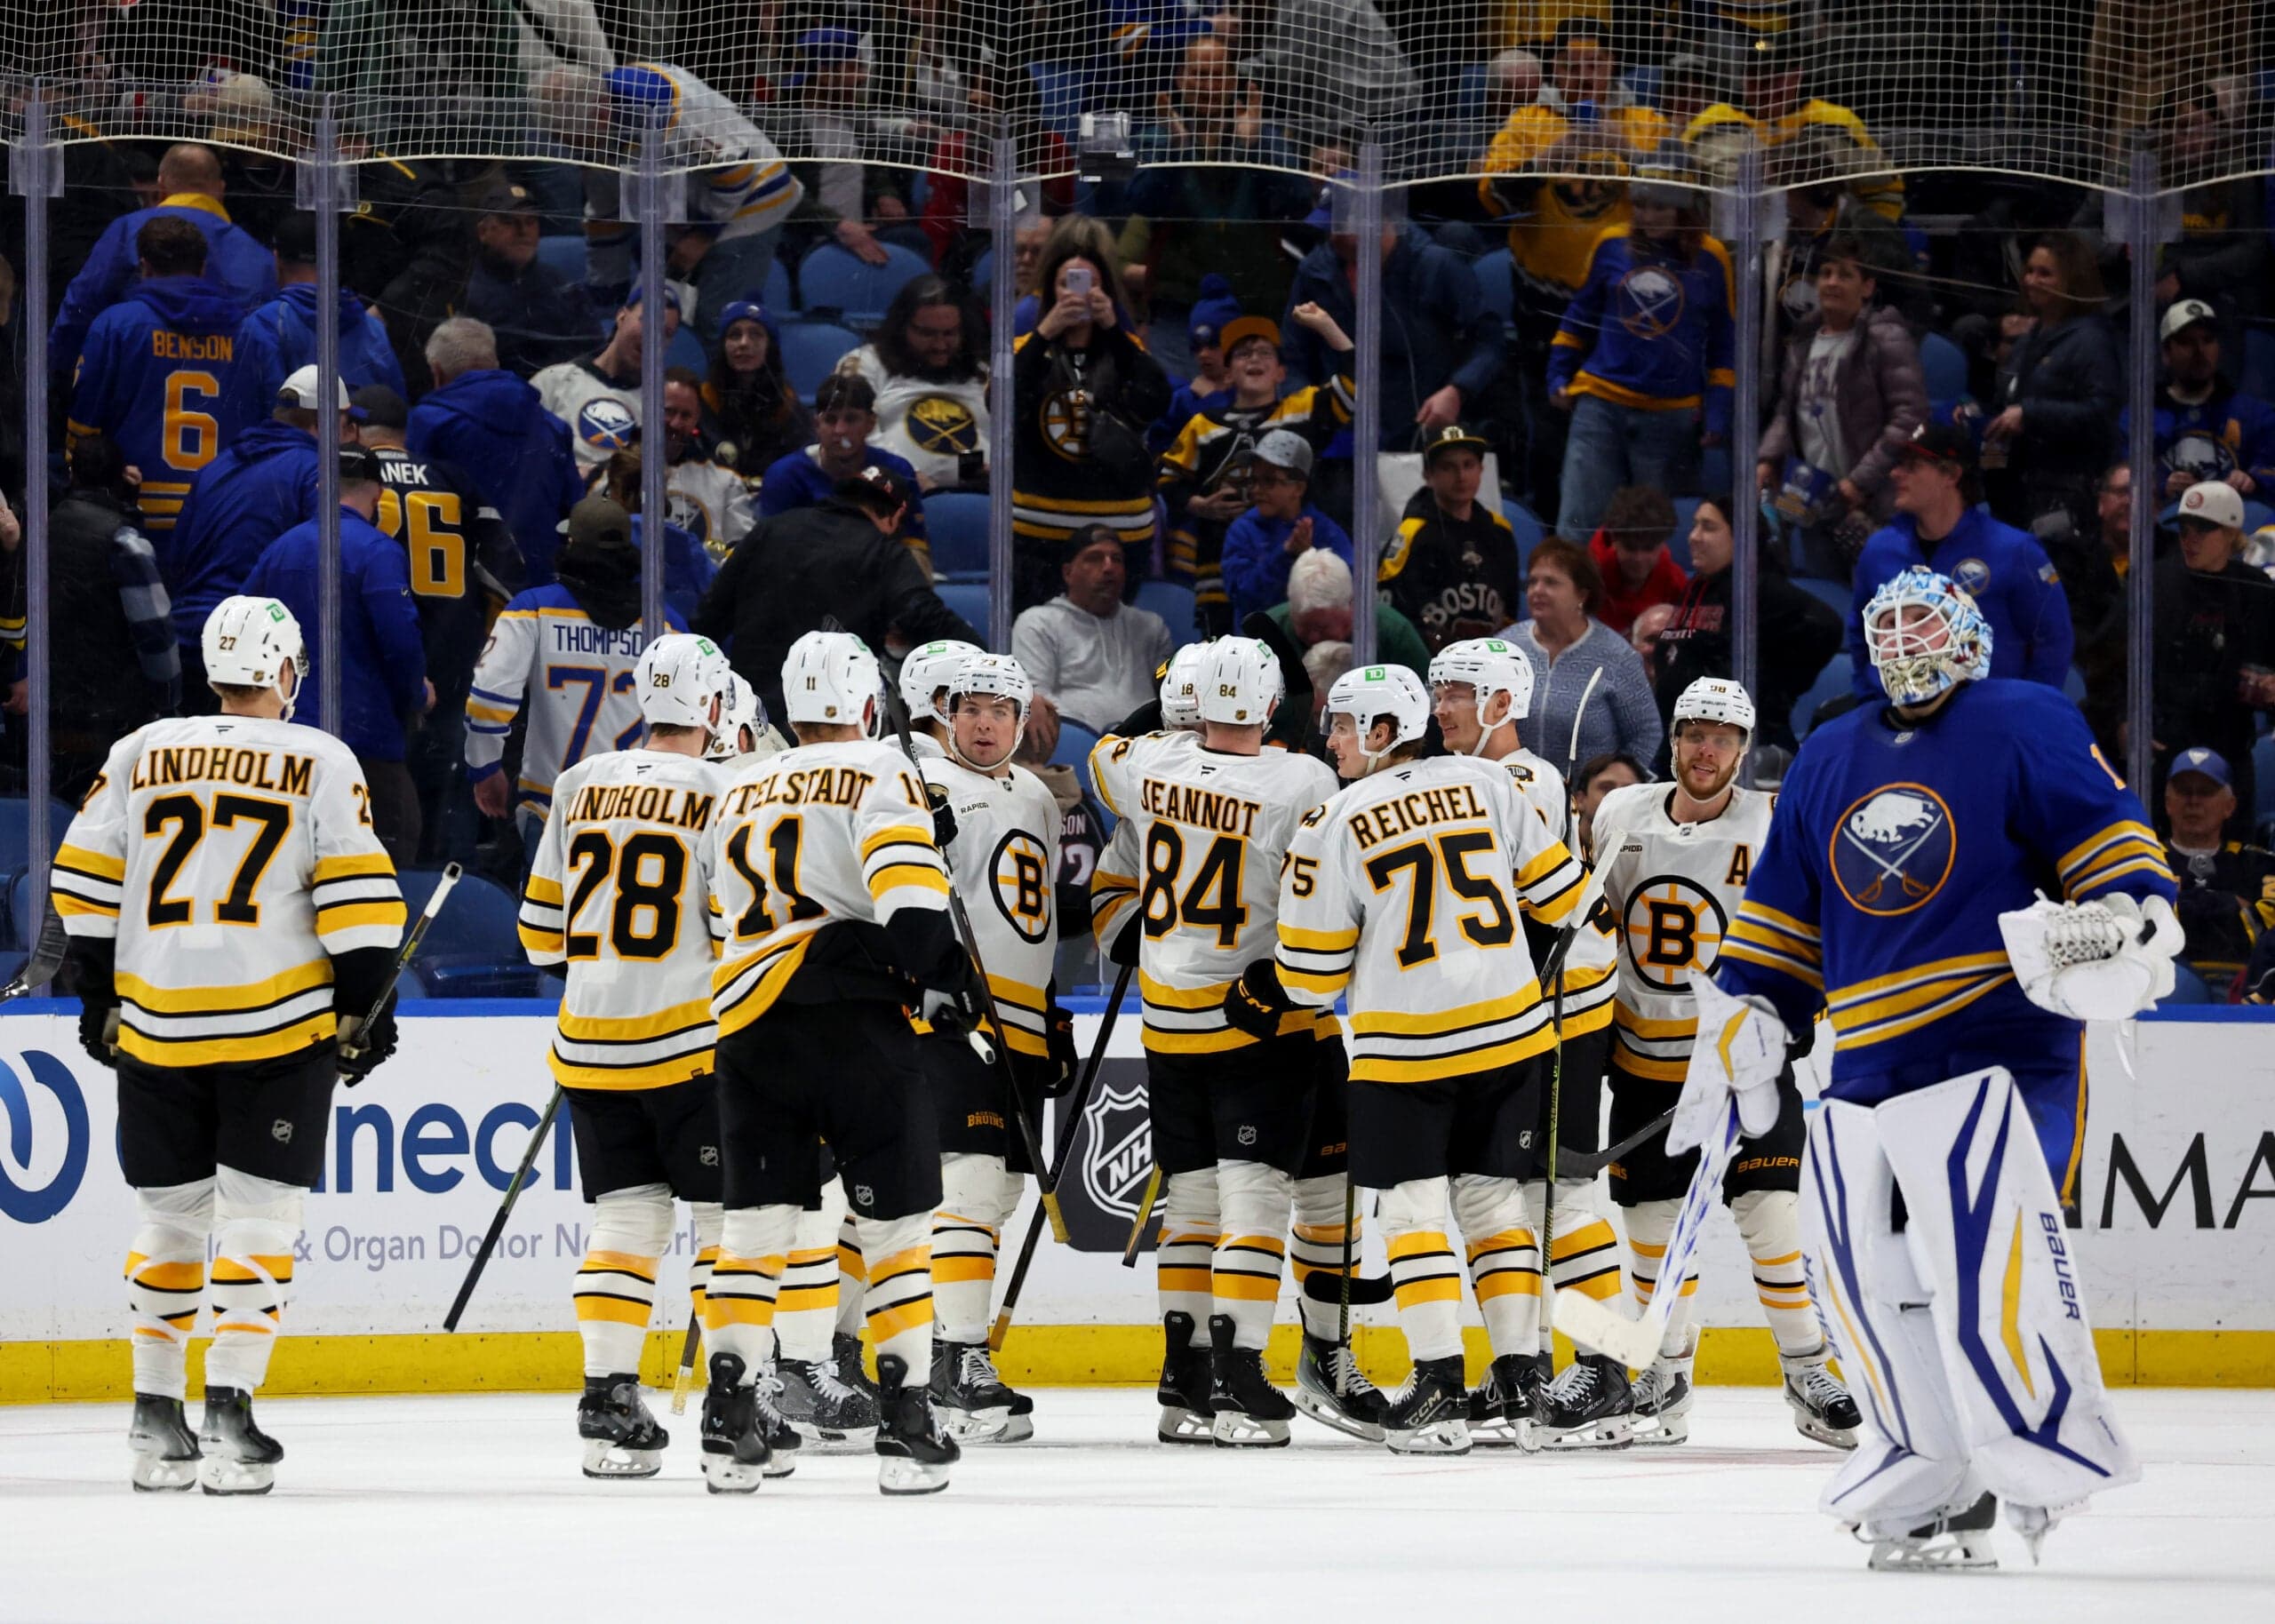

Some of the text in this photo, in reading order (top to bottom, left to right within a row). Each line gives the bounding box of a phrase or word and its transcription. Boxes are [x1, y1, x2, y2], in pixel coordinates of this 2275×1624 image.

[152, 330, 233, 362] BENSON
[161, 369, 220, 472] 6
[1422, 583, 1507, 625] BOSTO
[220, 635, 237, 651] 27
[553, 624, 643, 658] THOMPSO
[1489, 641, 1505, 651] TD
[653, 673, 670, 688] 28
[806, 676, 817, 690] 11
[1181, 682, 1194, 696] 18
[1219, 683, 1237, 699] 84
[1367, 668, 1384, 680] TD
[132, 747, 315, 797] LINDHOLM
[1140, 777, 1260, 838] JEANNOT
[1347, 784, 1489, 851] REICHEL
[144, 791, 293, 931] 27
[725, 813, 830, 943] 11
[1727, 843, 1752, 886] A
[565, 829, 690, 963] 28
[1142, 817, 1250, 950] 84
[1362, 826, 1517, 973] 75
[1238, 979, 1273, 1014] CM
[967, 1114, 1005, 1129] BRUINS
[1107, 1128, 1153, 1193] NH
[1737, 1157, 1800, 1174] BAUER
[323, 1225, 426, 1272] Organ
[2040, 1211, 2080, 1321] BAUER
